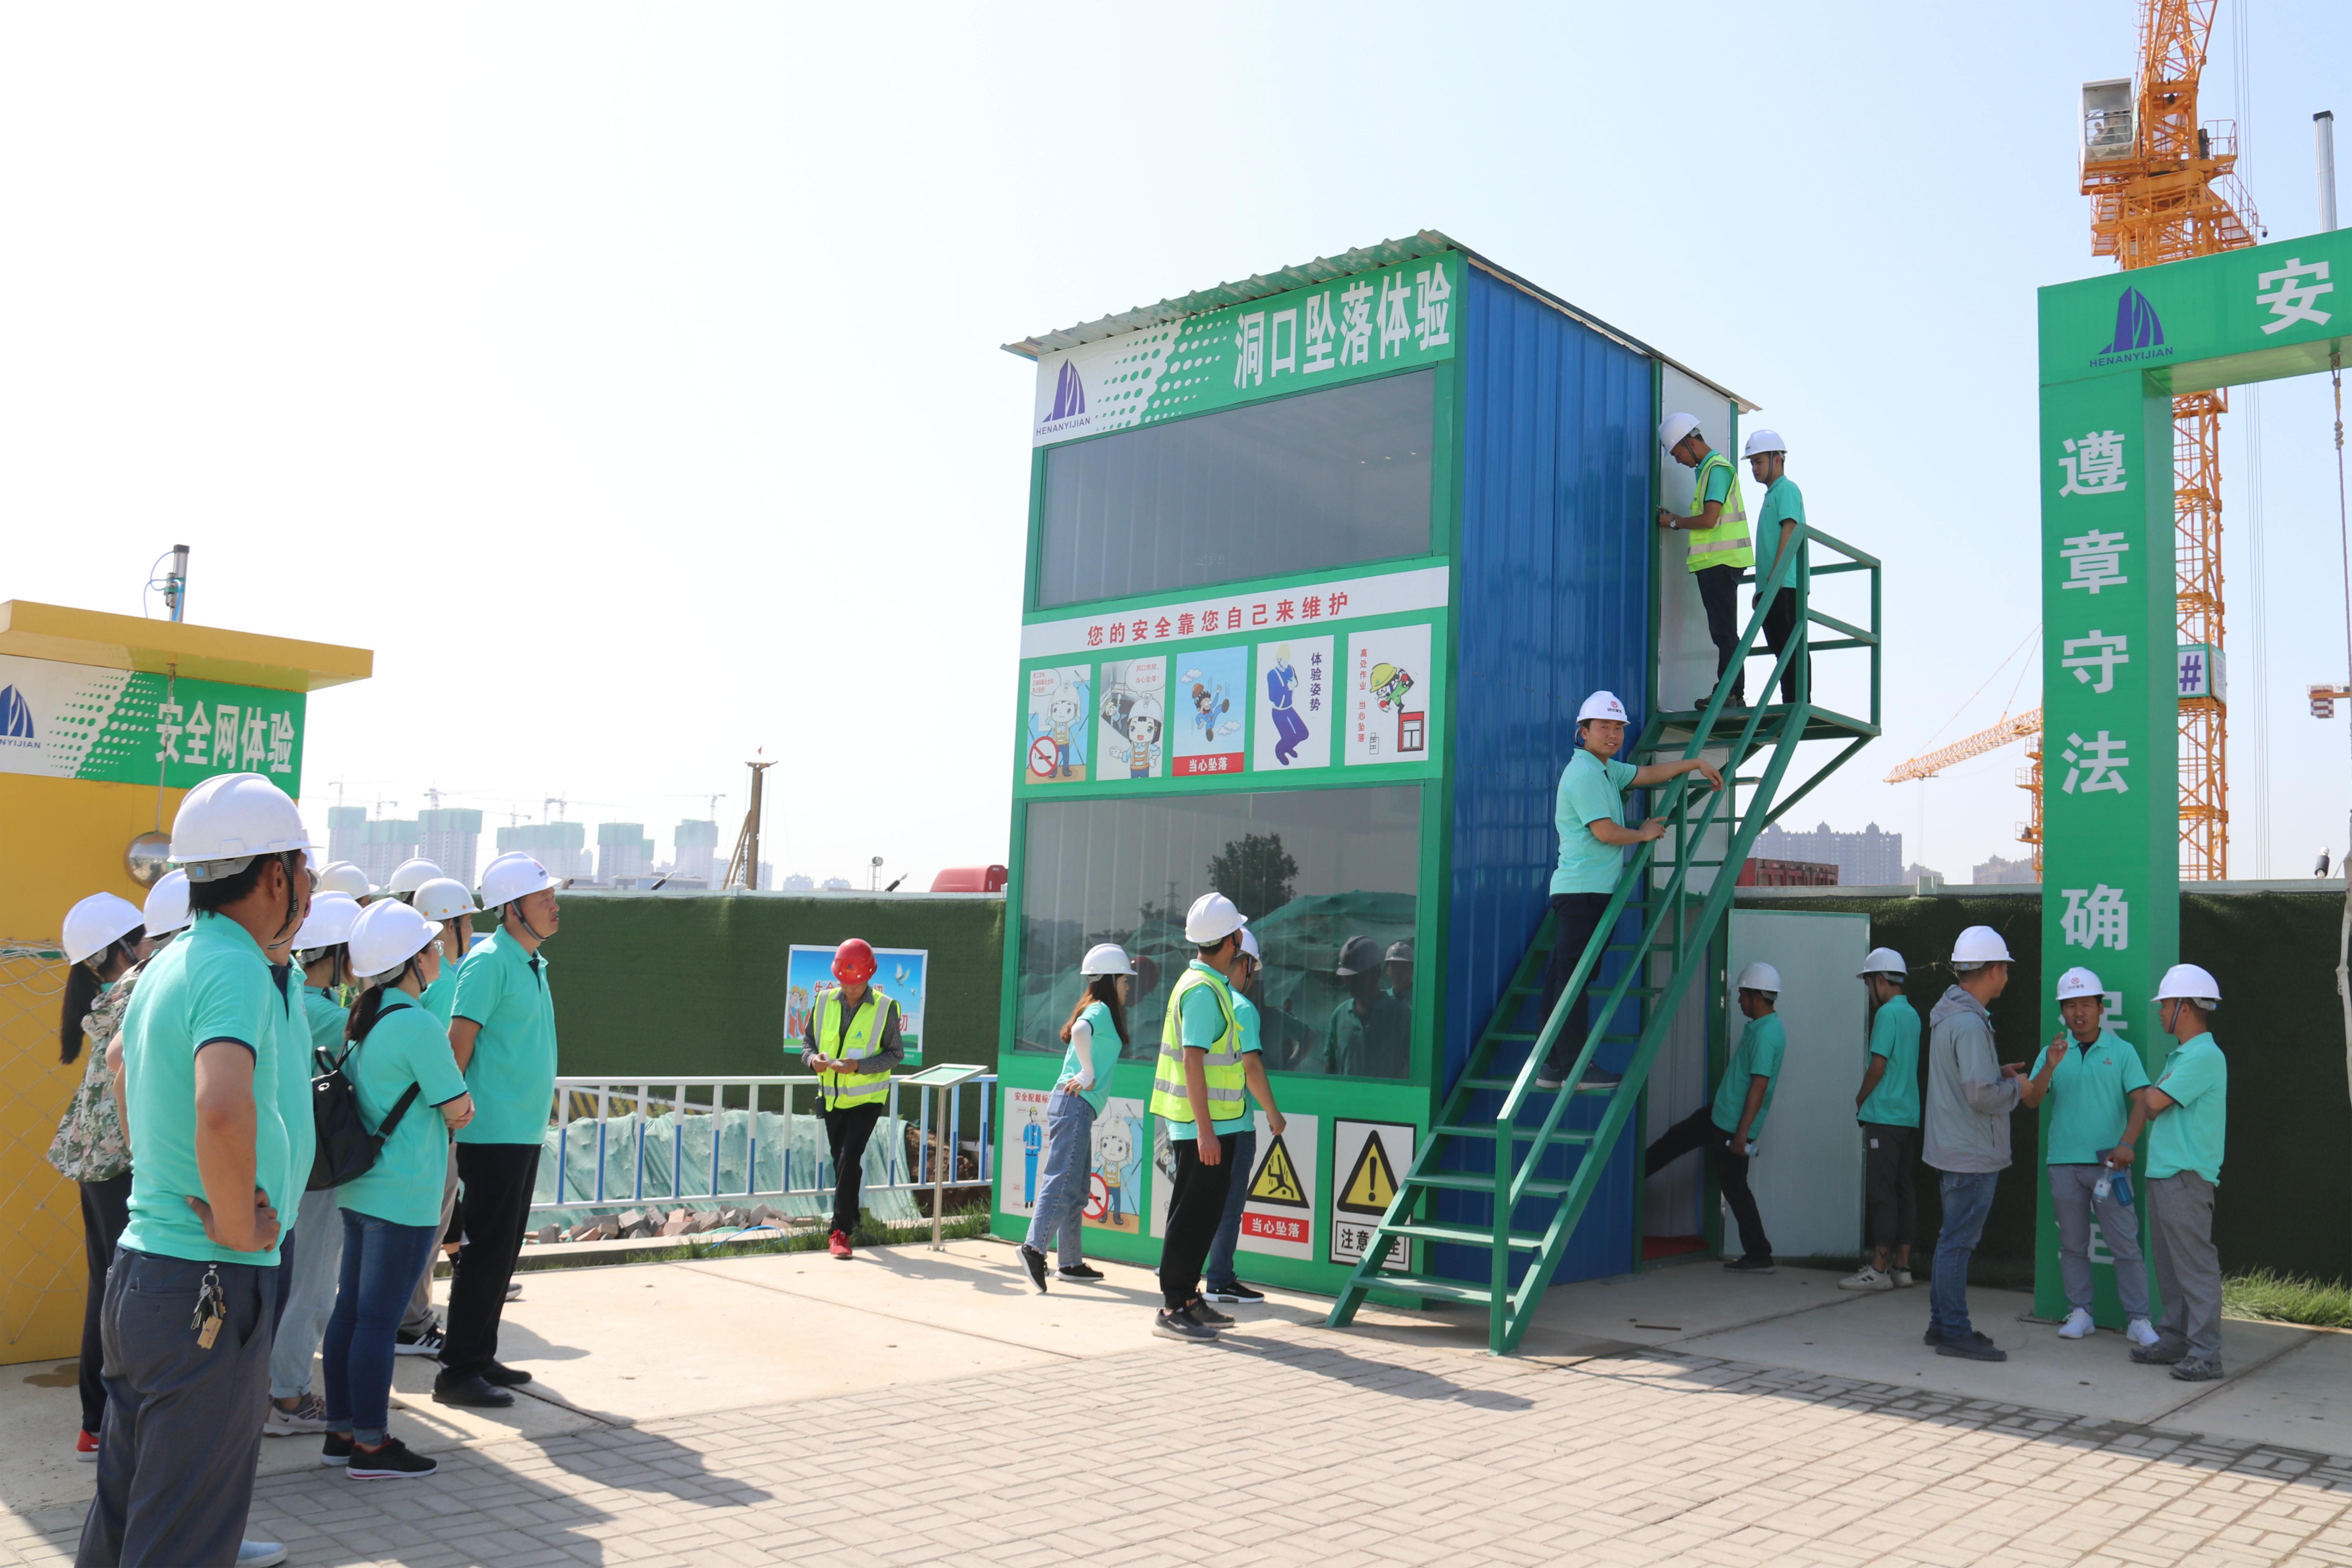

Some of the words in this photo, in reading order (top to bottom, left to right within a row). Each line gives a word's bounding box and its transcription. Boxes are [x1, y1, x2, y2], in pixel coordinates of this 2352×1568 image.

[2256, 257, 2334, 335] 安
[1233, 262, 1452, 389] 洞口坠落体验
[2089, 347, 2174, 368] HENANYIJIAN
[1036, 417, 1091, 436] HENANYIJIAN
[1087, 592, 1349, 647] 您的安全靠您自己来维护
[1310, 652, 1322, 711] 体验姿势
[1359, 648, 1367, 690] 高处作业
[2179, 655, 2201, 692] #
[155, 696, 295, 773] 安全网体验
[1357, 701, 1366, 743] 当心坠落
[1188, 757, 1228, 773] 当心坠落
[1014, 1091, 1051, 1103] 安全配戴标
[1251, 1217, 1301, 1238] 当心坠落
